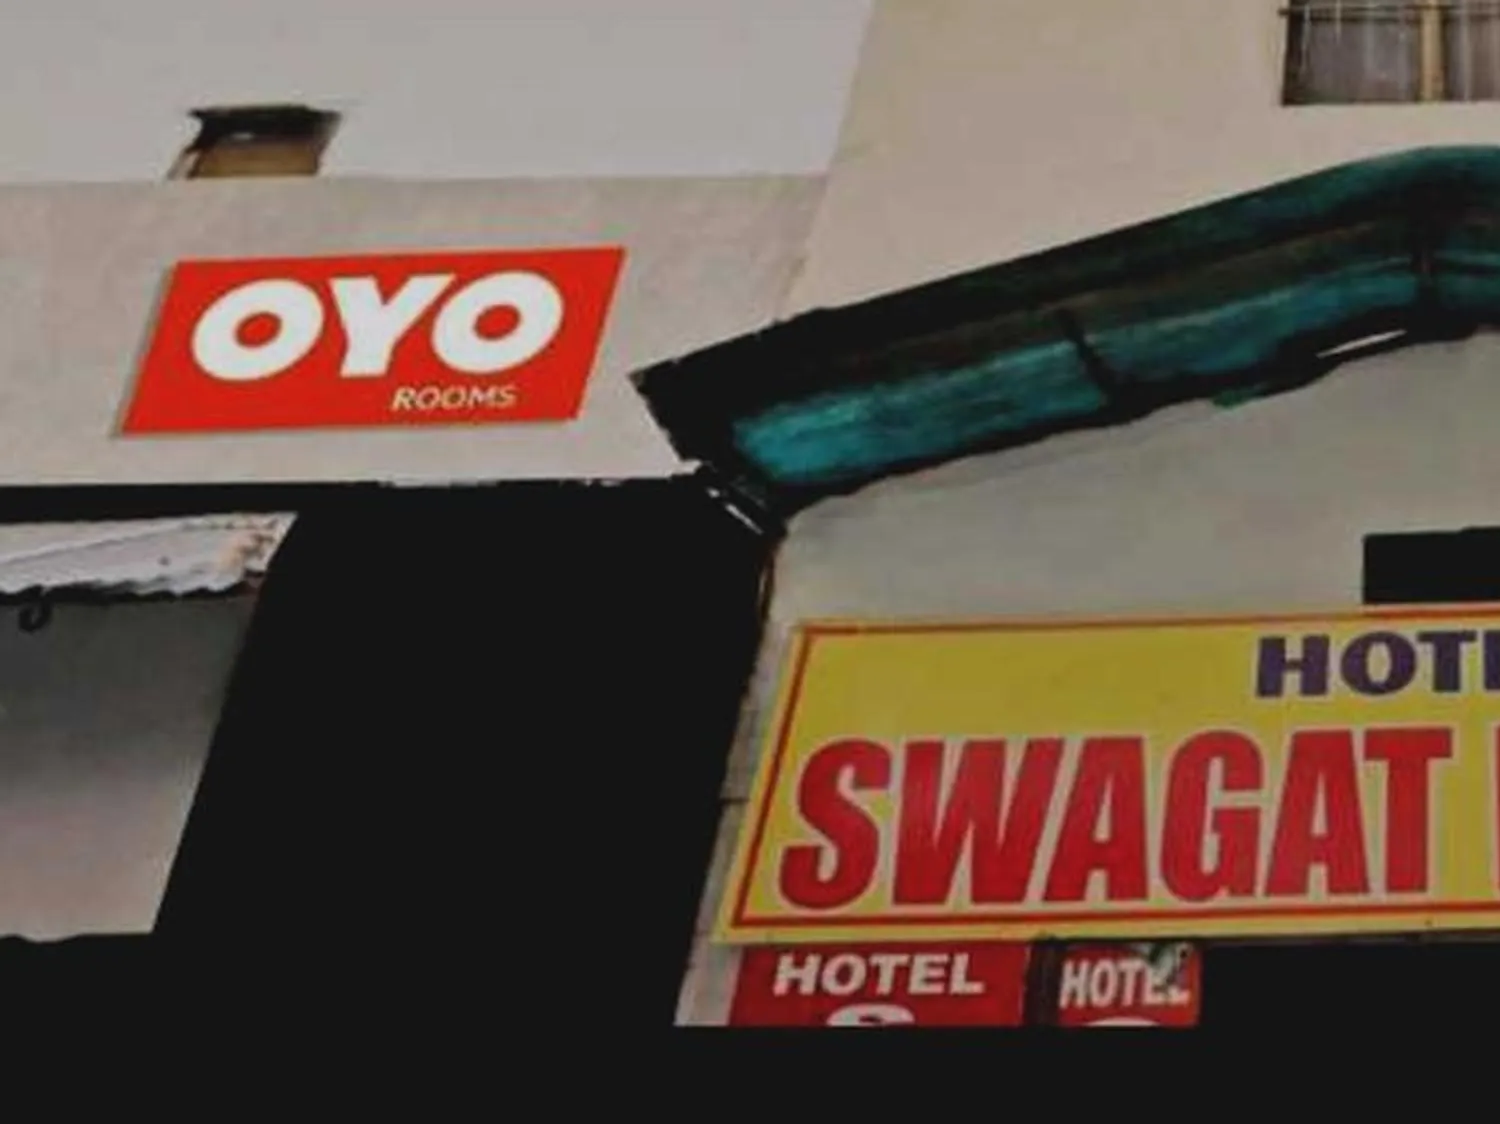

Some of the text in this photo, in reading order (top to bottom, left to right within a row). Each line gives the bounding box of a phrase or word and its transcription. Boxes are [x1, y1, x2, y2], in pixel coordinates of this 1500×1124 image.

[191, 270, 564, 381] OYO
[391, 384, 518, 412] ROOMS
[779, 727, 1453, 910] SWAGAT
[772, 952, 985, 996] HOTEL
[1059, 958, 1190, 1008] HOTEL
